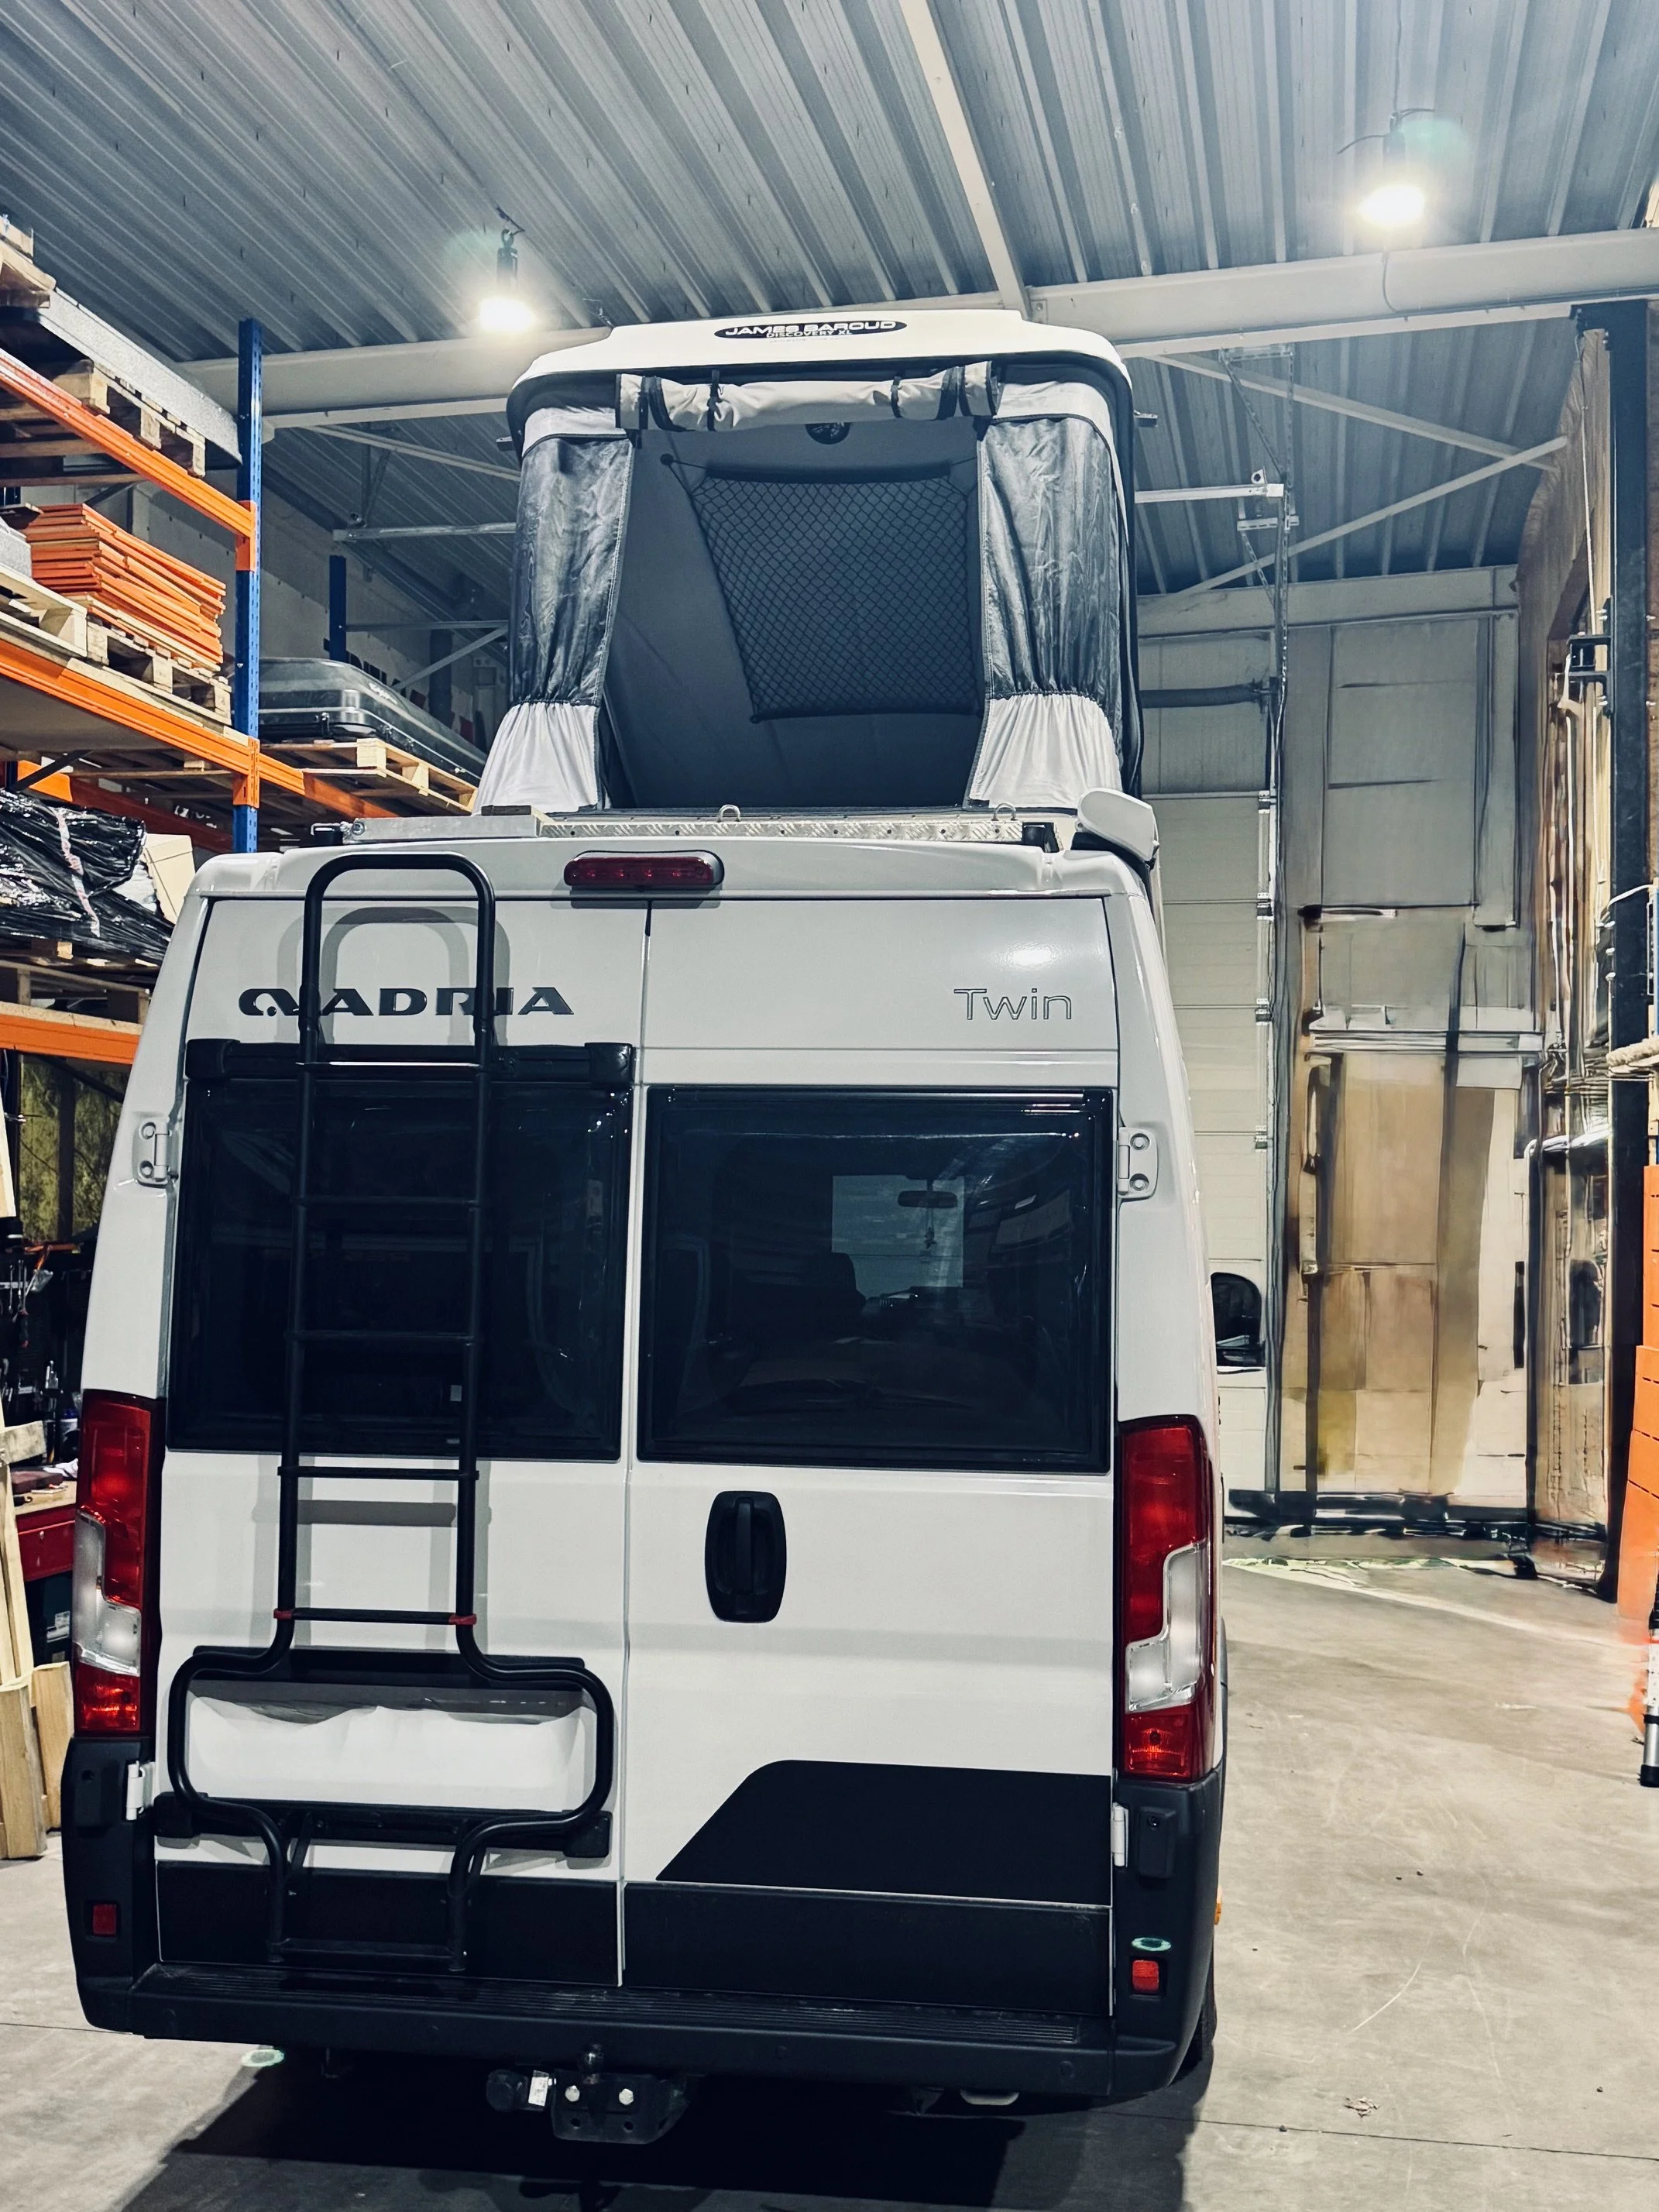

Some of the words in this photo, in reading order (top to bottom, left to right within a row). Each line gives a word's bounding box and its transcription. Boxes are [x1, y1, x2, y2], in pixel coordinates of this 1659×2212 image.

[725, 325, 799, 336] JAMES
[803, 321, 896, 331] BAROUD
[318, 987, 575, 1015] ADRIA
[953, 988, 1072, 1020] Twin
